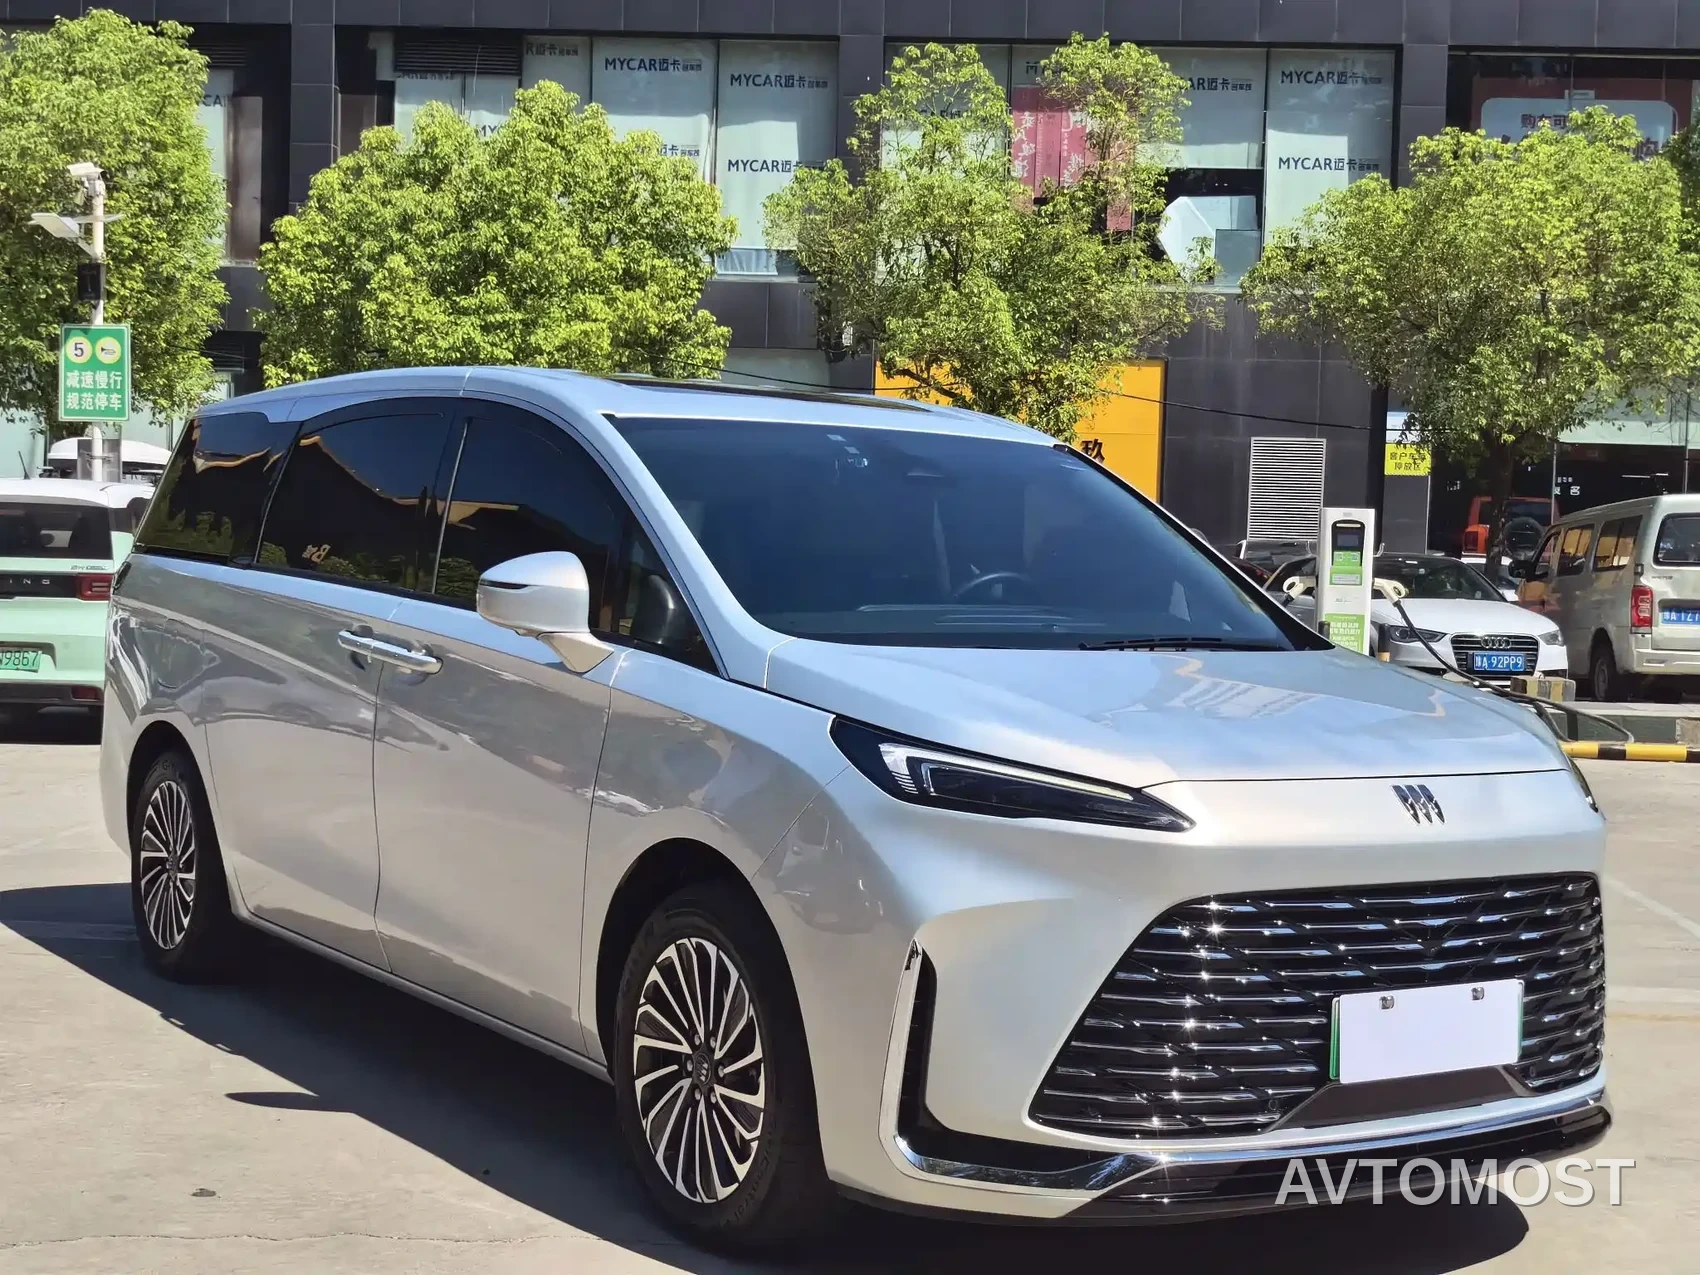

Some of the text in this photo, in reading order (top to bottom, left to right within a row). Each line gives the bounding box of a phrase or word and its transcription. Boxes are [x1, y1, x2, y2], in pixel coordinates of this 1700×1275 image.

[74, 342, 84, 358] 5
[66, 369, 122, 389] 减速慢行
[66, 391, 122, 411] 规范停车
[0, 650, 39, 667] 9867
